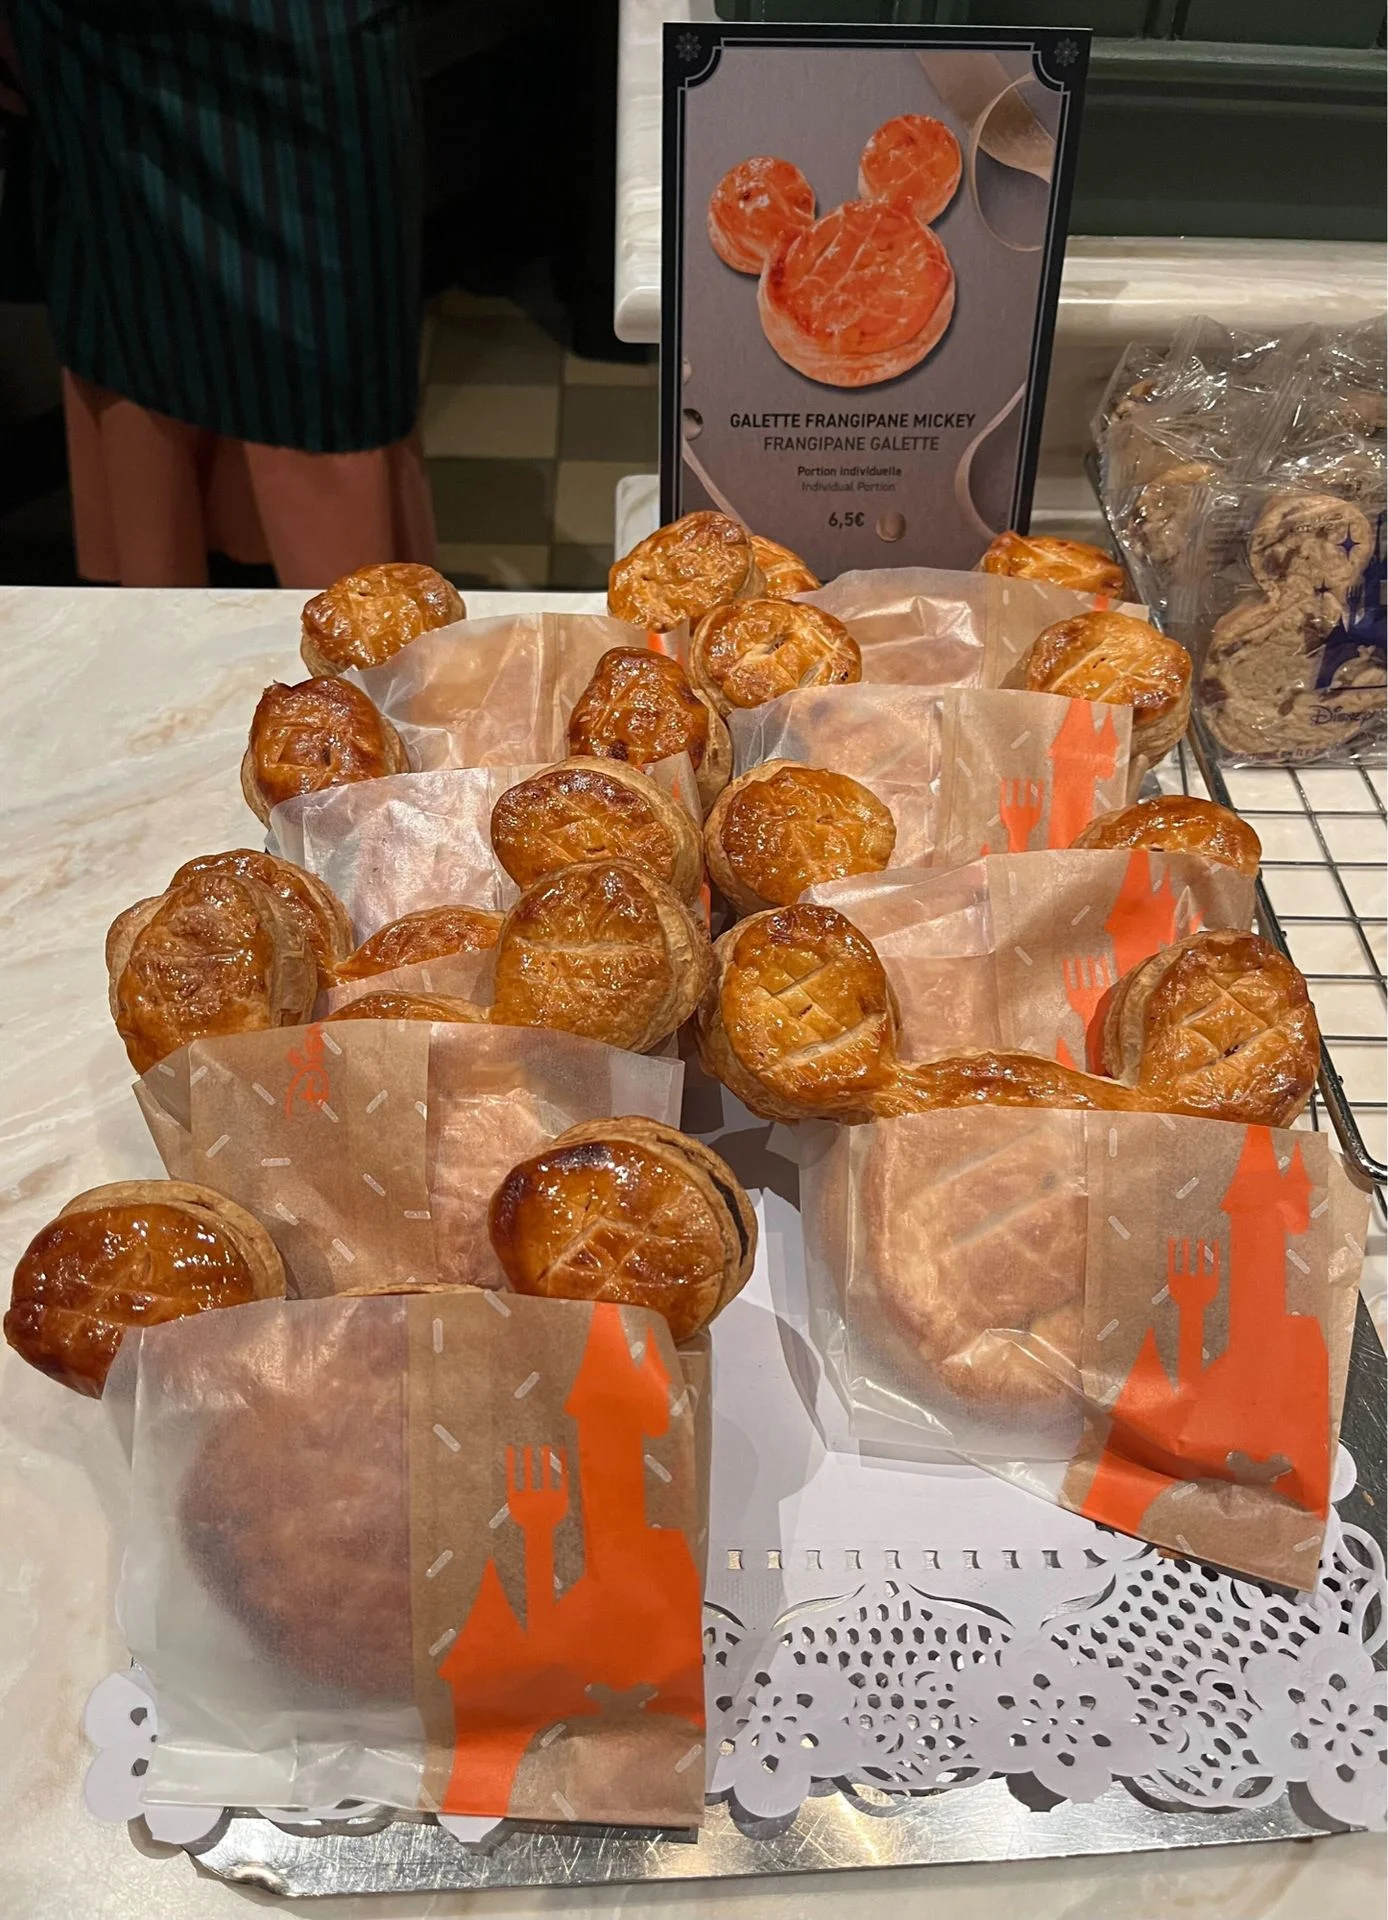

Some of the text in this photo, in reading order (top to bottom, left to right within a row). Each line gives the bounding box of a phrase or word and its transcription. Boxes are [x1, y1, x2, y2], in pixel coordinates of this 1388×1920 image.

[729, 413, 976, 428] GALETTE FRANGIPANE MICKEY
[764, 436, 940, 451] FRANGIPANE GALETTE
[797, 466, 836, 477] Portion
[801, 481, 897, 492] Individual Portion
[828, 511, 866, 529] 6,5€
[1309, 704, 1377, 726] Disney
